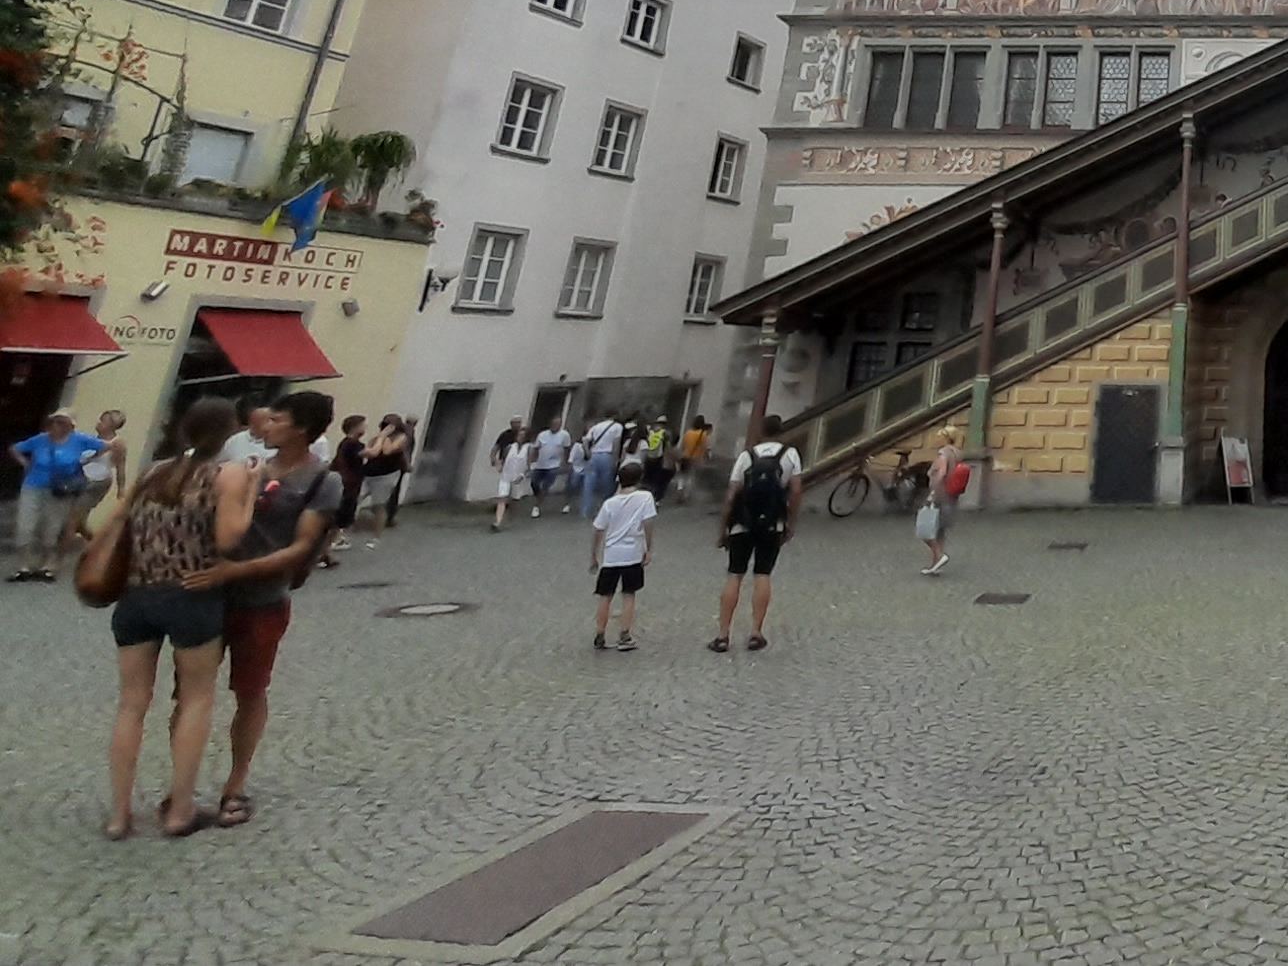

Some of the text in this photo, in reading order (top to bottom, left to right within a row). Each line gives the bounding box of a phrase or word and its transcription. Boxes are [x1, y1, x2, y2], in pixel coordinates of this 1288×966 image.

[169, 233, 357, 269] MARTIN KOCH
[164, 260, 351, 291] FOTOSERVICE
